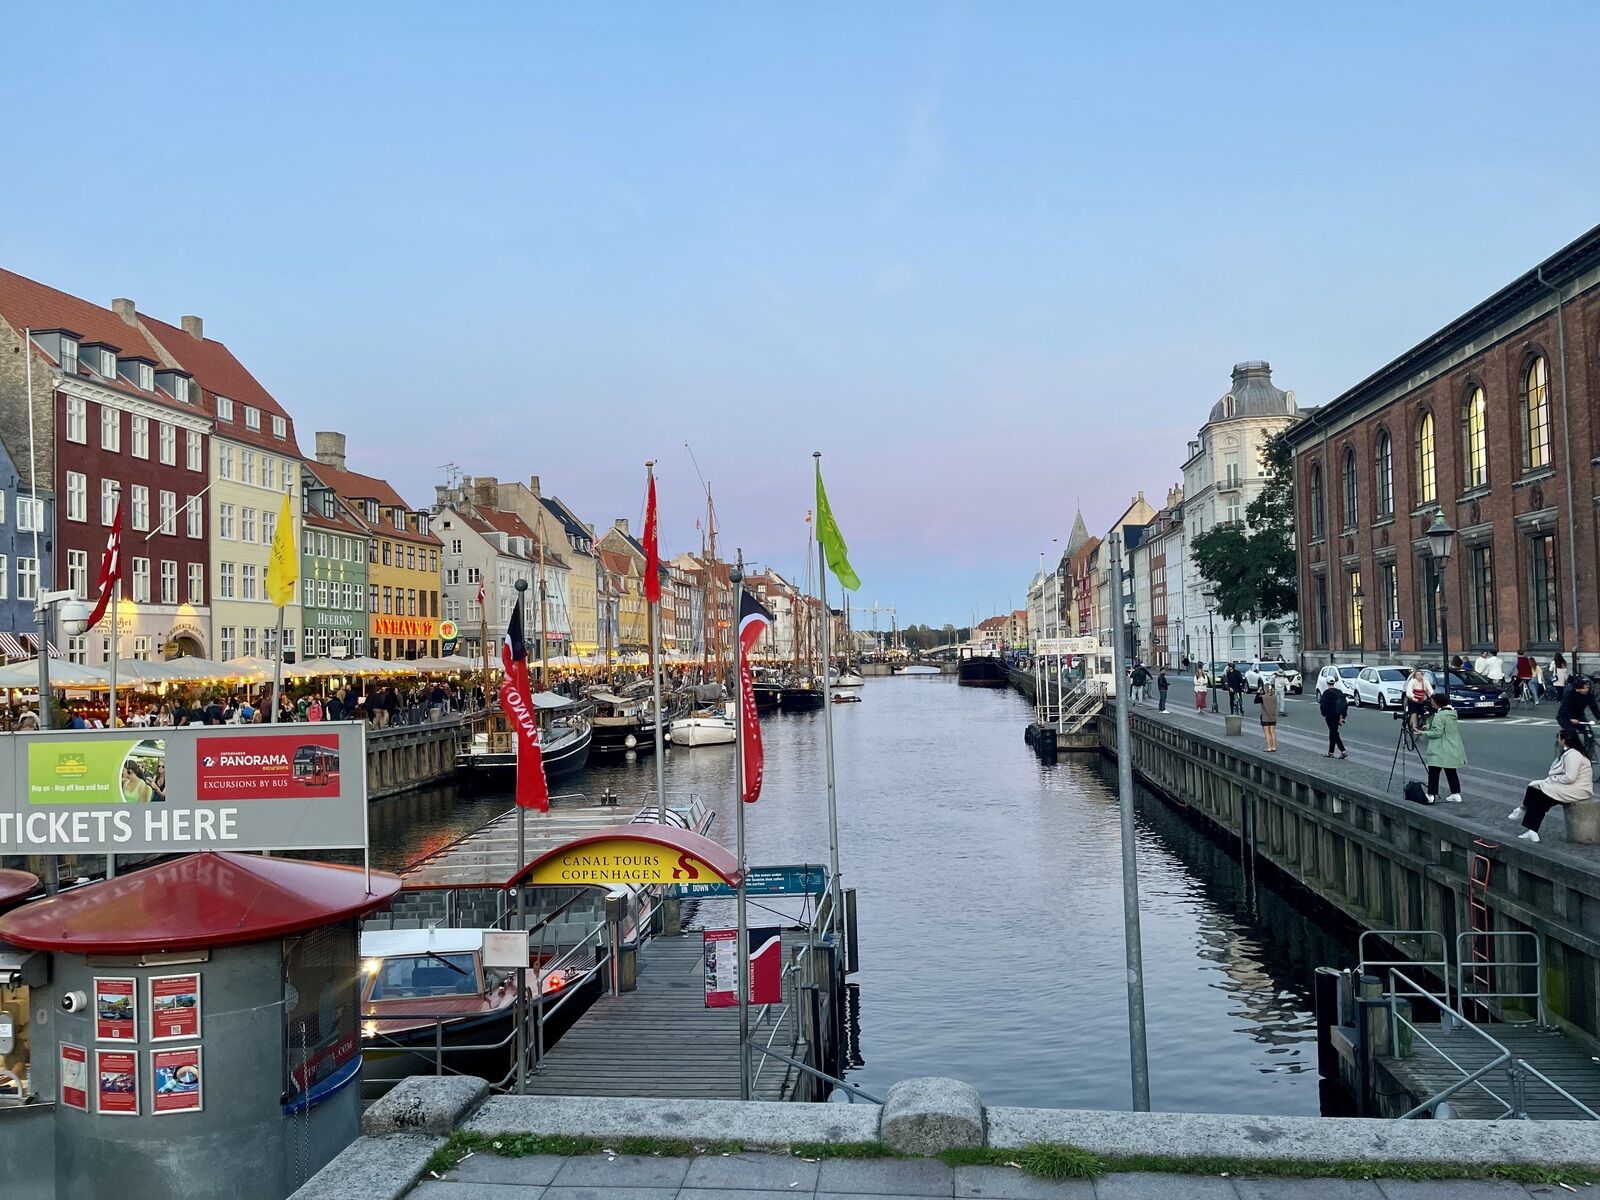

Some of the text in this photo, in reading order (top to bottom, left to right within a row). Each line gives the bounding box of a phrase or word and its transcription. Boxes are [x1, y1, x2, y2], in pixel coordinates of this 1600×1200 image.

[317, 612, 353, 626] HEERING
[376, 618, 434, 635] NYHAVN 17
[1392, 621, 1401, 631] P
[220, 755, 289, 767] PANORAMA
[66, 783, 74, 791] off
[97, 783, 109, 791] boat
[204, 779, 288, 789] EXCURSIONS BY BUS
[0, 808, 238, 844] TICKETS HERE
[563, 855, 659, 867] CANAL TOURS
[562, 869, 661, 880] COPENHAGEN
[693, 884, 709, 892] DOWN
